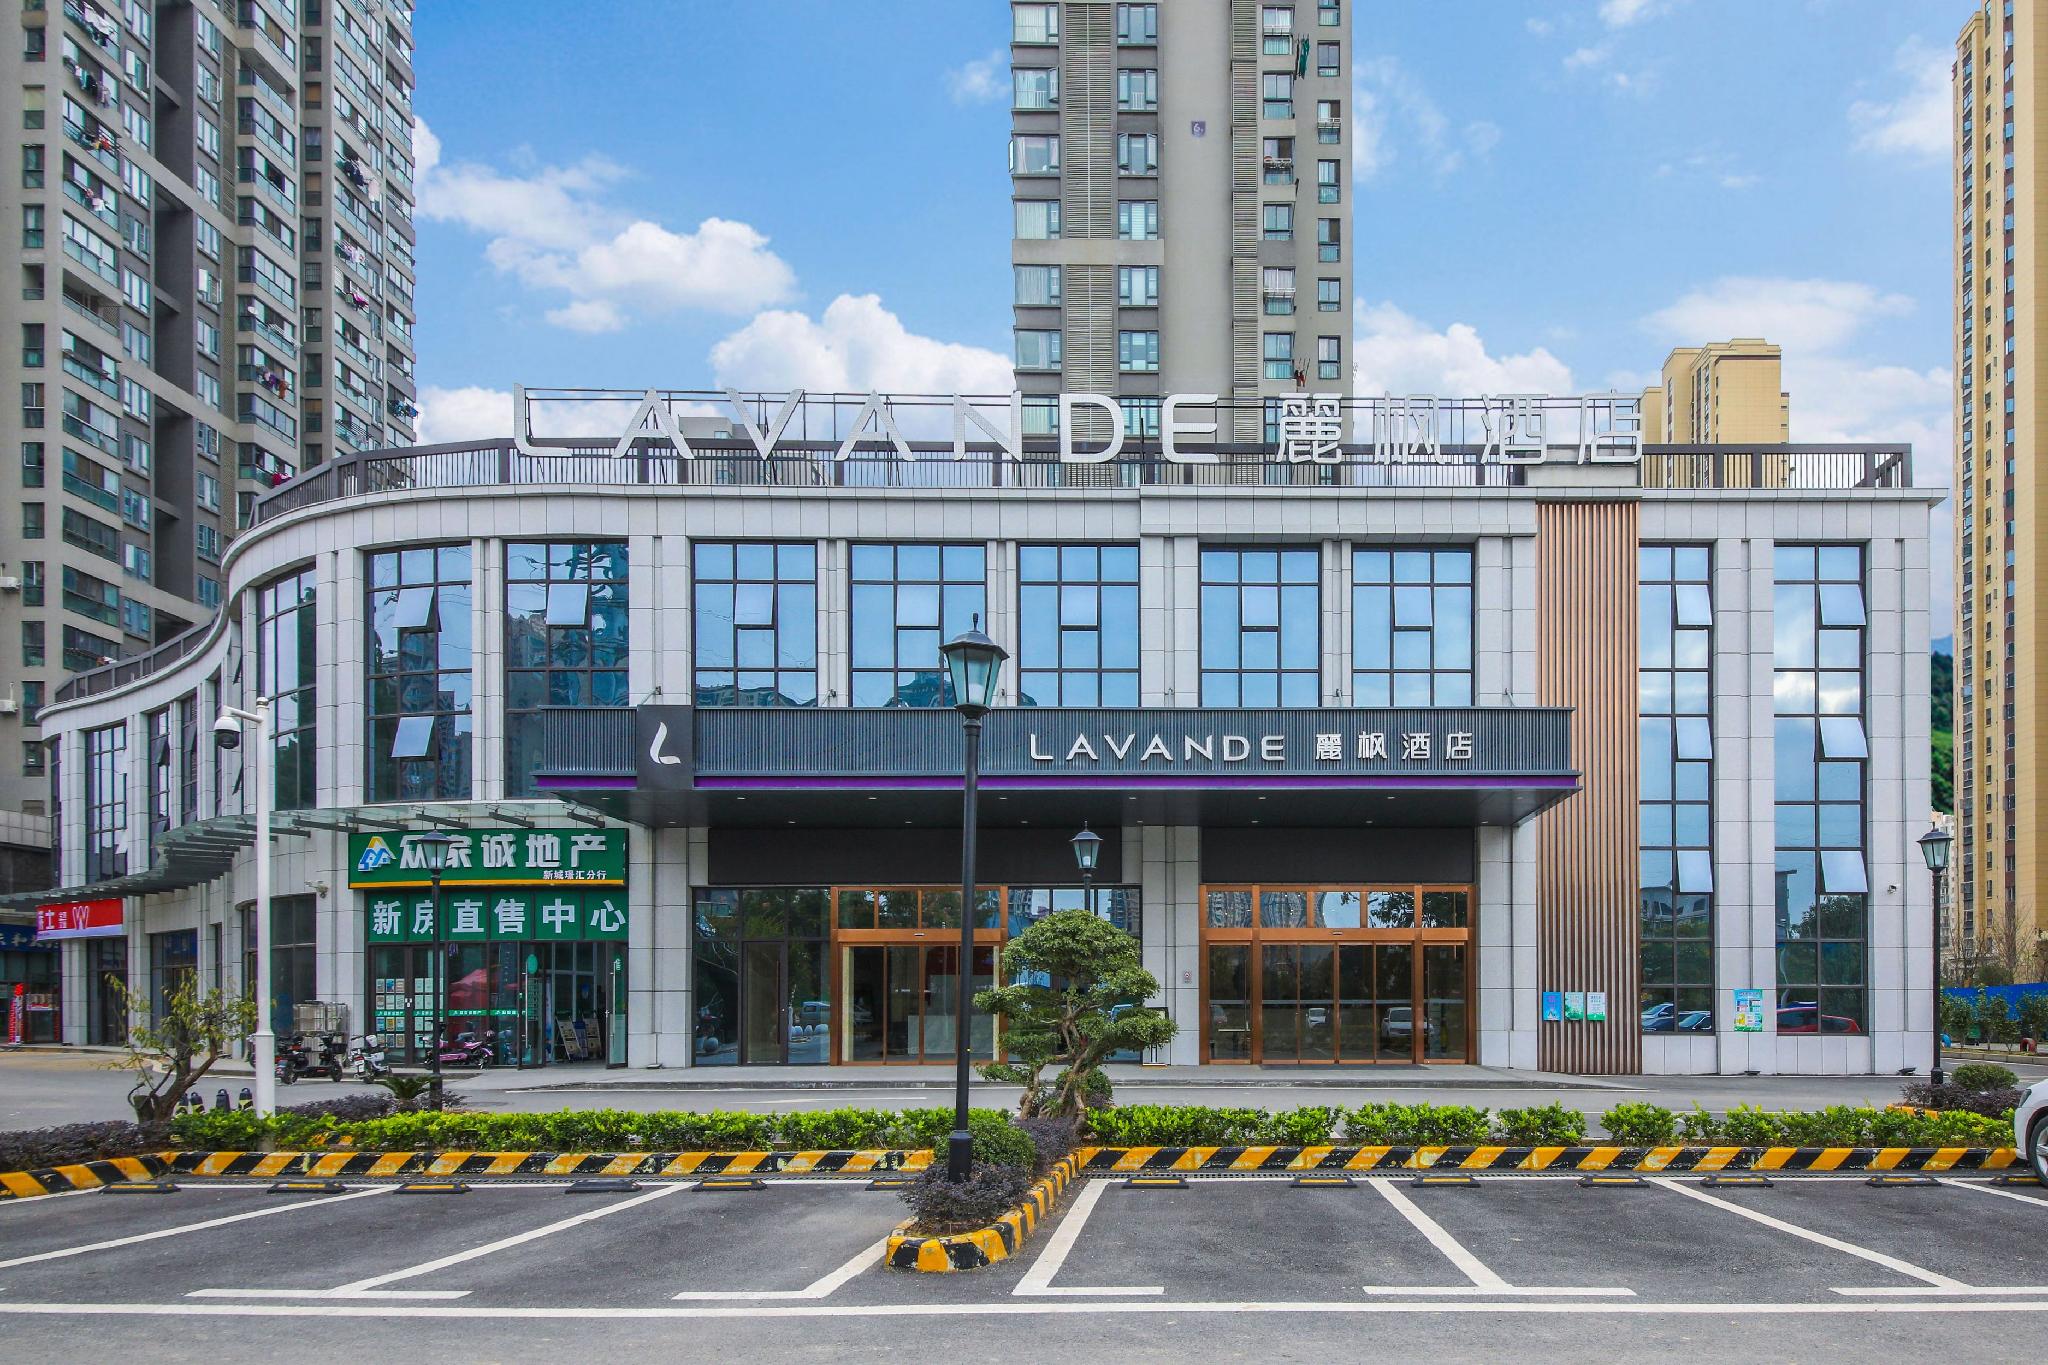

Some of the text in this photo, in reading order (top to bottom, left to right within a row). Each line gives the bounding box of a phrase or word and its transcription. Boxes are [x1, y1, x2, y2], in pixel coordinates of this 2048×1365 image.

[514, 383, 1642, 465] LAVANDE 麗枫酒店
[1030, 731, 1473, 762] LAVANDE 麗枫酒店
[373, 898, 626, 934] 新房直售中心
